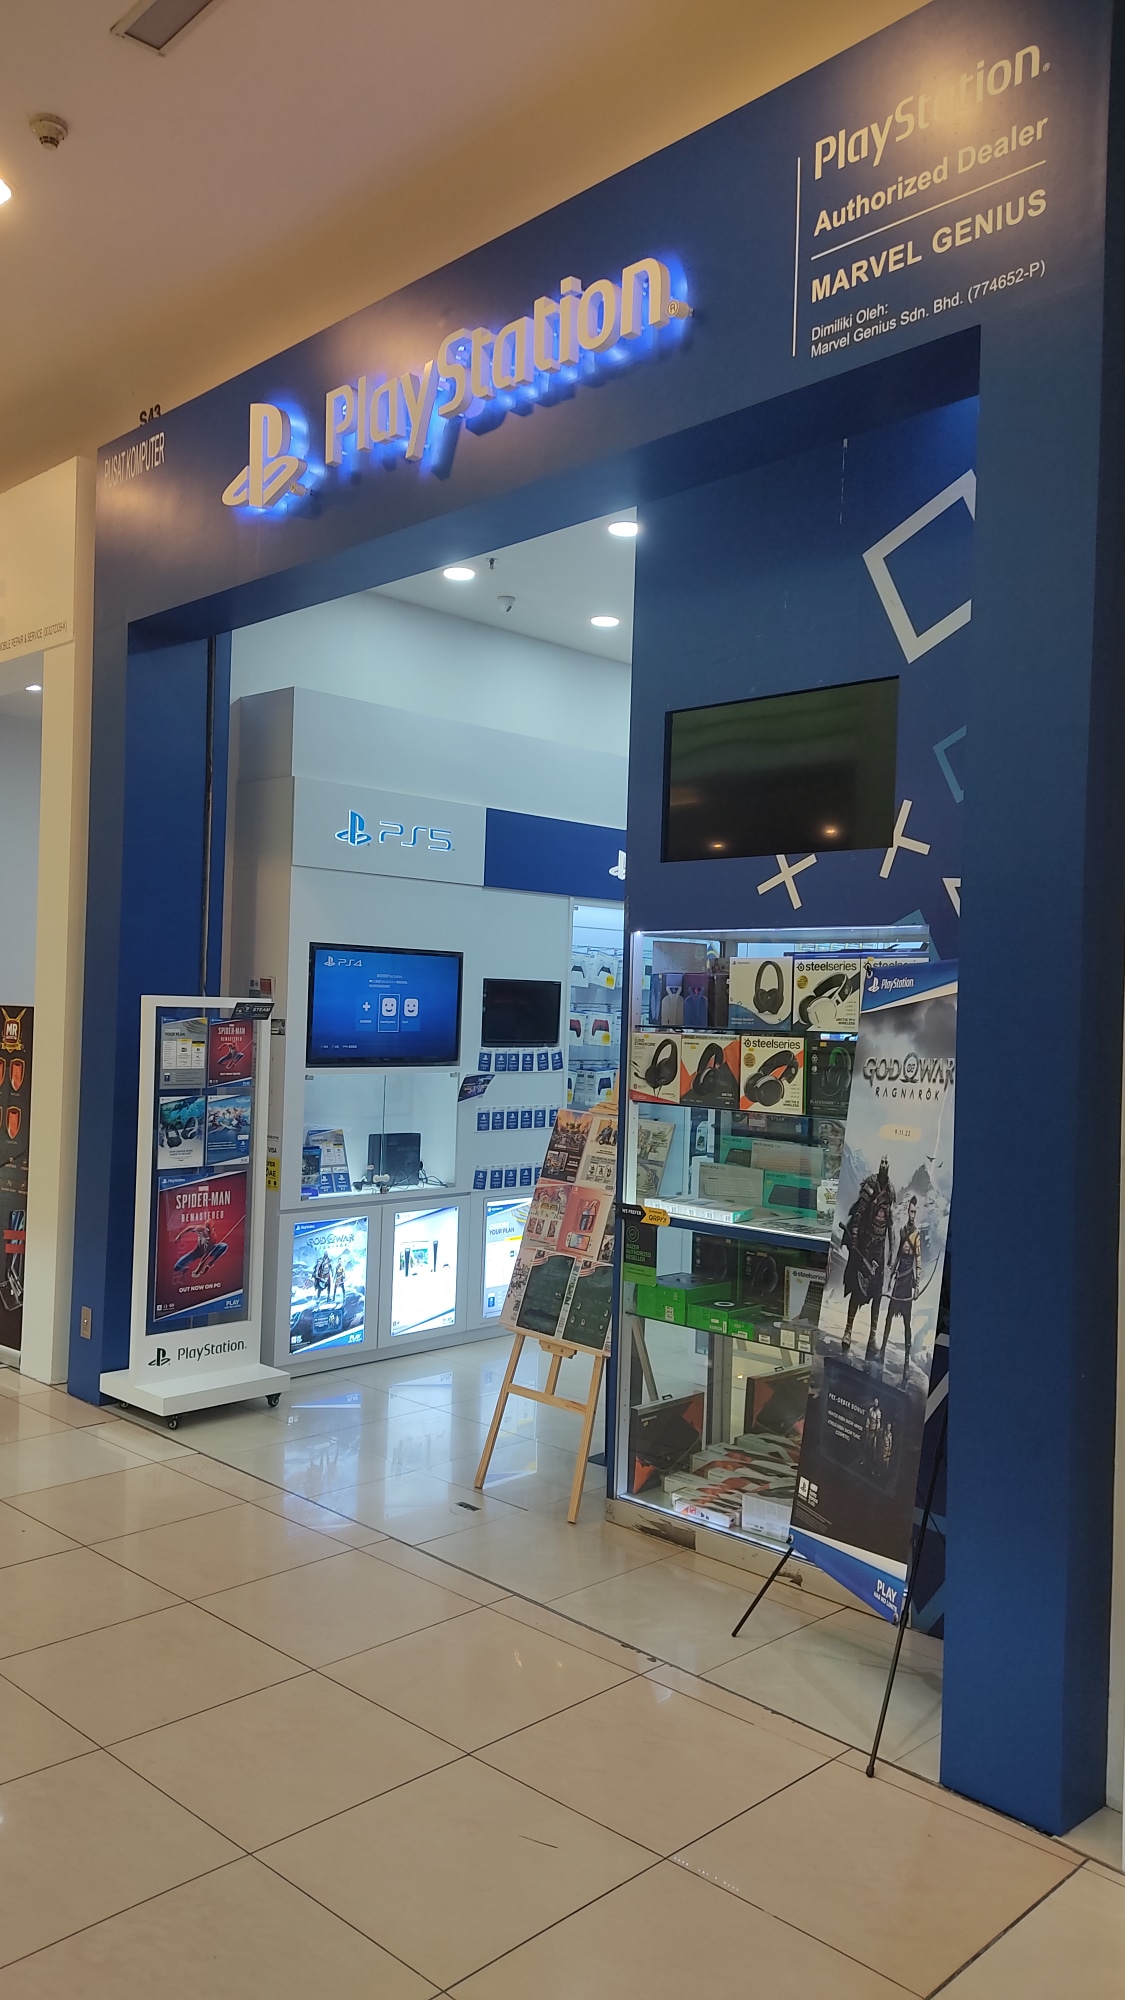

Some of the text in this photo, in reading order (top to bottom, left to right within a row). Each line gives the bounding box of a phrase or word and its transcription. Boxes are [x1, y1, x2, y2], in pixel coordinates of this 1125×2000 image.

[814, 45, 1040, 181] PlayStation
[813, 117, 1048, 236] Authorized Dealer
[811, 189, 1047, 303] MARVEL GENIUS
[811, 259, 1046, 359] Marvel Genius Sdn. Bhd. (774652-P)
[811, 303, 889, 341] Dimiliki Oleh:
[325, 258, 671, 466] PlayStation
[105, 431, 165, 487] PUSAT KOMPUTER
[379, 821, 451, 852] PS5
[338, 958, 363, 967] PS4
[806, 961, 857, 972] steelseries
[881, 977, 914, 992] PlayStation
[6, 1024, 17, 1036] MR
[218, 1027, 246, 1035] SPIDER-MAN
[752, 1039, 800, 1049] steelseries
[863, 1058, 901, 1088] GOD
[920, 1058, 955, 1093] WAR
[176, 1191, 231, 1209] SPIDER-MAN
[182, 1210, 224, 1223] REMASTERED
[178, 1340, 244, 1361] PlayStation
[877, 1579, 897, 1603] PLAY
